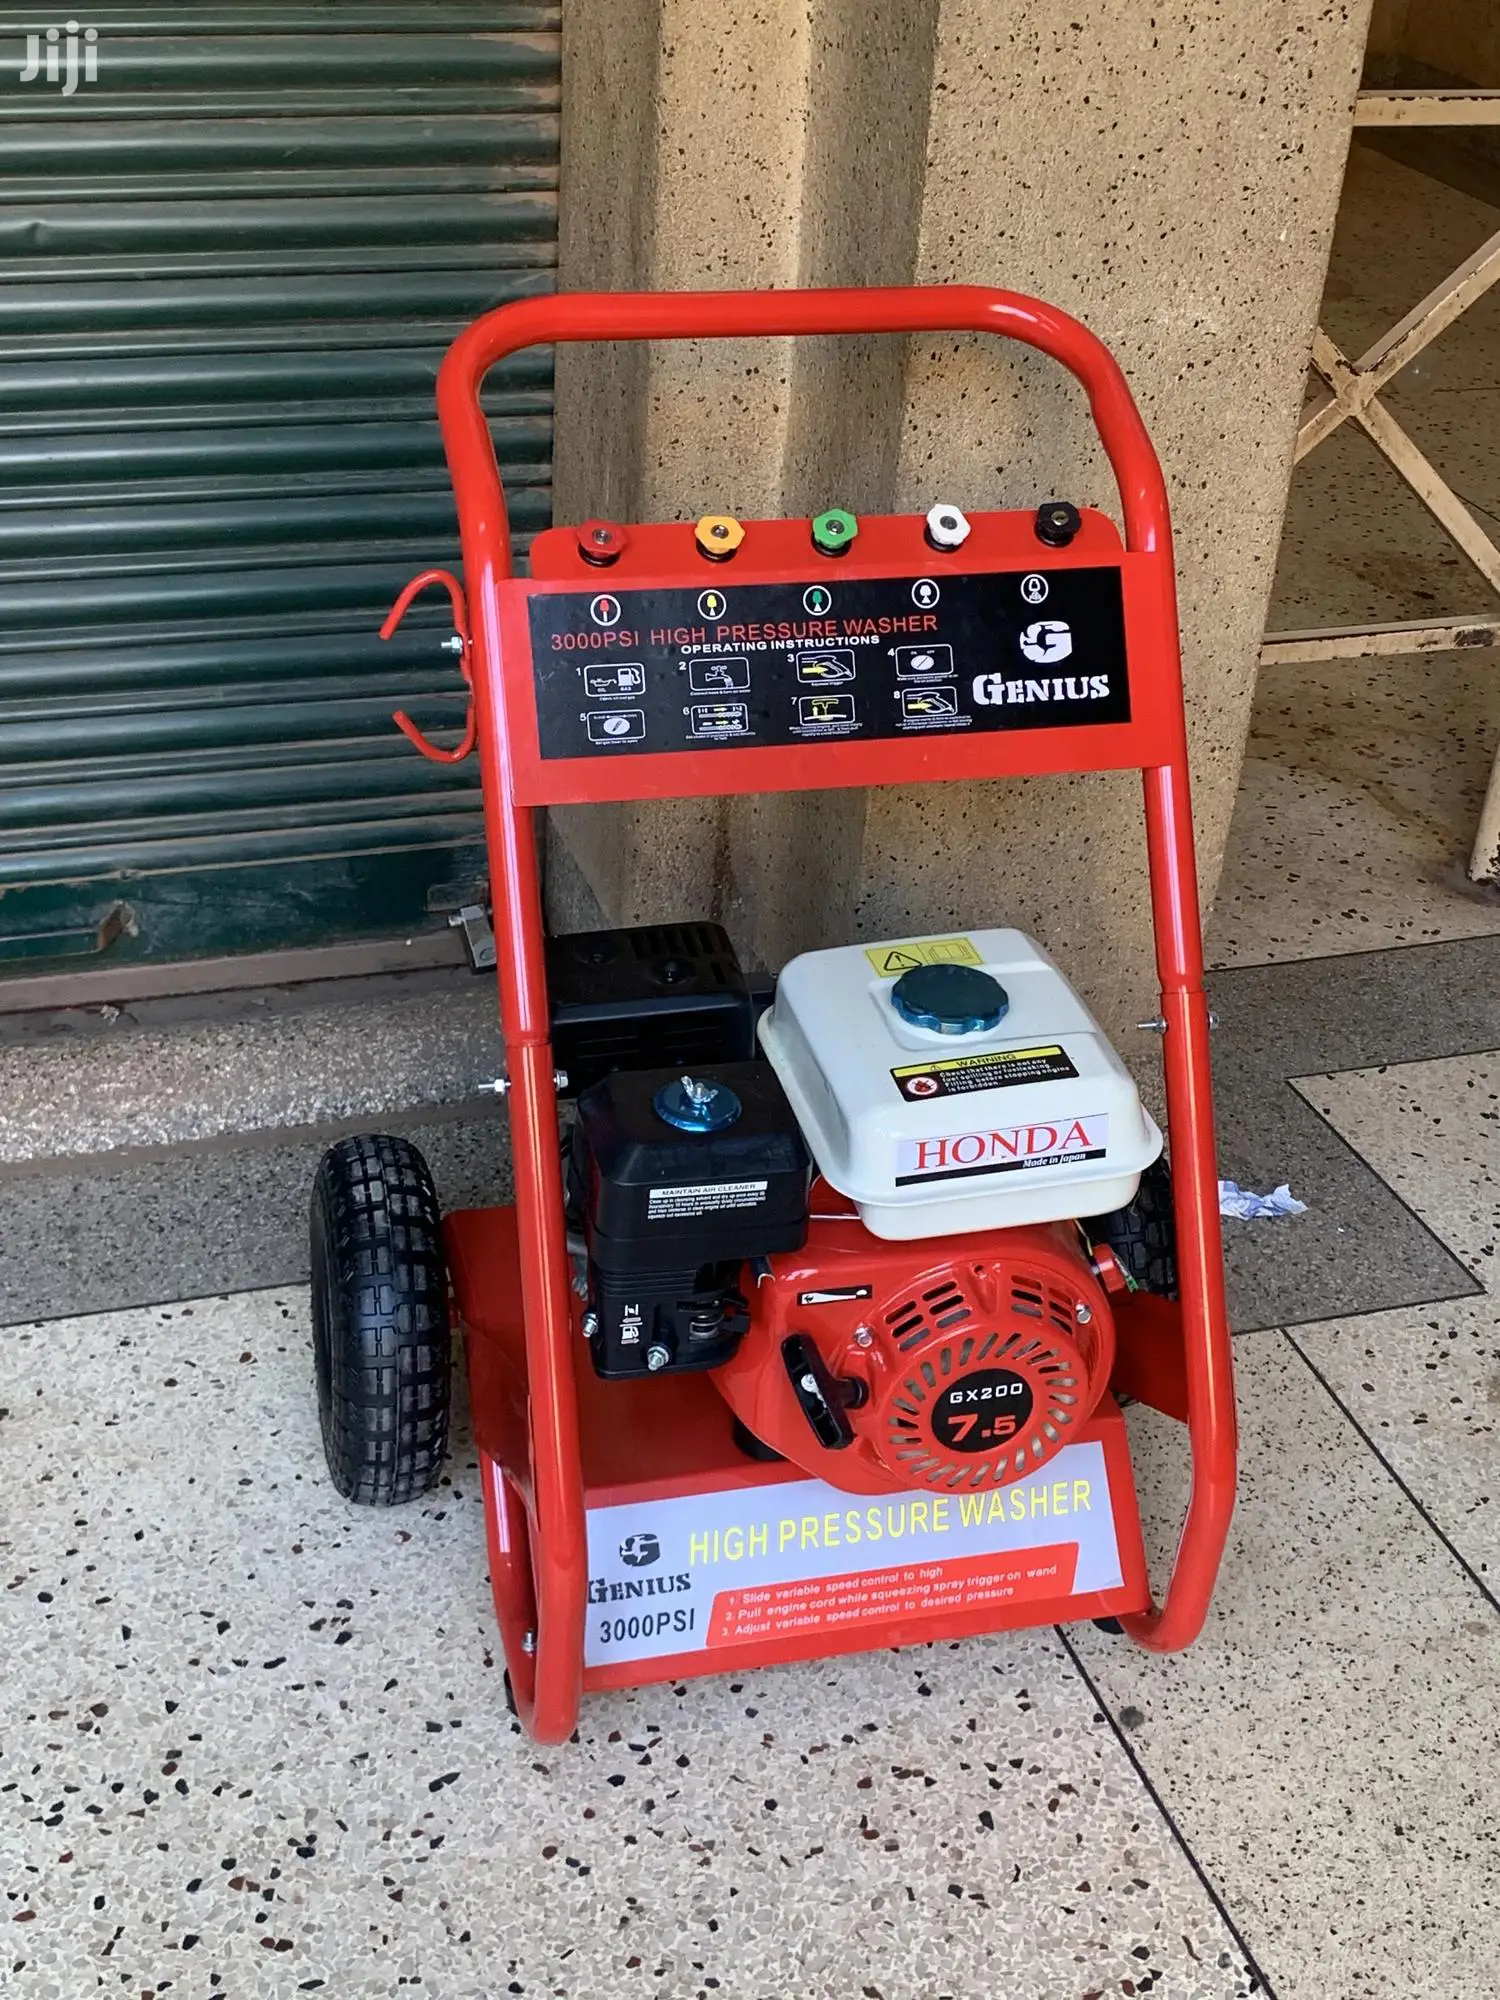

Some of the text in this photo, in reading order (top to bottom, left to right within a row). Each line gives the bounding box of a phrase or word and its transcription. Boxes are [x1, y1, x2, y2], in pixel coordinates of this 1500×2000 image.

[551, 615, 939, 651] 3000PSI HIGH PRESSURE WASHER
[681, 635, 880, 654] OPERATING INSTRUCTIONS
[887, 648, 895, 657] 4
[679, 661, 687, 670] 2
[787, 653, 795, 662] 3
[576, 667, 582, 676] 1
[893, 690, 900, 699] 8
[972, 673, 1110, 705] GENIUS
[791, 697, 798, 705] 7
[580, 713, 587, 721] 5
[683, 707, 690, 715] 6
[956, 1053, 1017, 1067] WARNING
[914, 1120, 1093, 1170] HONDA
[1023, 1152, 1086, 1168] Made in Japan
[662, 1188, 701, 1196] MAINTAIN
[717, 1184, 756, 1192] CLEANER
[949, 1382, 1023, 1404] GX200
[948, 1413, 1016, 1442] 7.5
[689, 1480, 1091, 1566] HIGH PRESSURE WASHER
[738, 1607, 761, 1620] Pull
[767, 1602, 807, 1616] engine
[809, 1597, 835, 1610] cord
[838, 1592, 868, 1606] while
[871, 1583, 931, 1602] squeezing
[933, 1579, 965, 1594] spray
[967, 1573, 1004, 1588] trigger
[1007, 1571, 1021, 1580] on
[1027, 1564, 1057, 1579] wand
[742, 1592, 771, 1605] Slide
[776, 1583, 820, 1599] variable
[826, 1578, 859, 1593] speed
[861, 1572, 899, 1586] control
[903, 1570, 915, 1580] to
[919, 1566, 943, 1579] high
[735, 1621, 771, 1636] Adjust
[776, 1613, 820, 1630] variable
[826, 1608, 859, 1624] speed
[861, 1603, 900, 1617] control
[904, 1600, 915, 1610] to
[921, 1594, 962, 1609] desired
[966, 1586, 1014, 1604] pressure
[600, 1608, 695, 1643] 3000PSI
